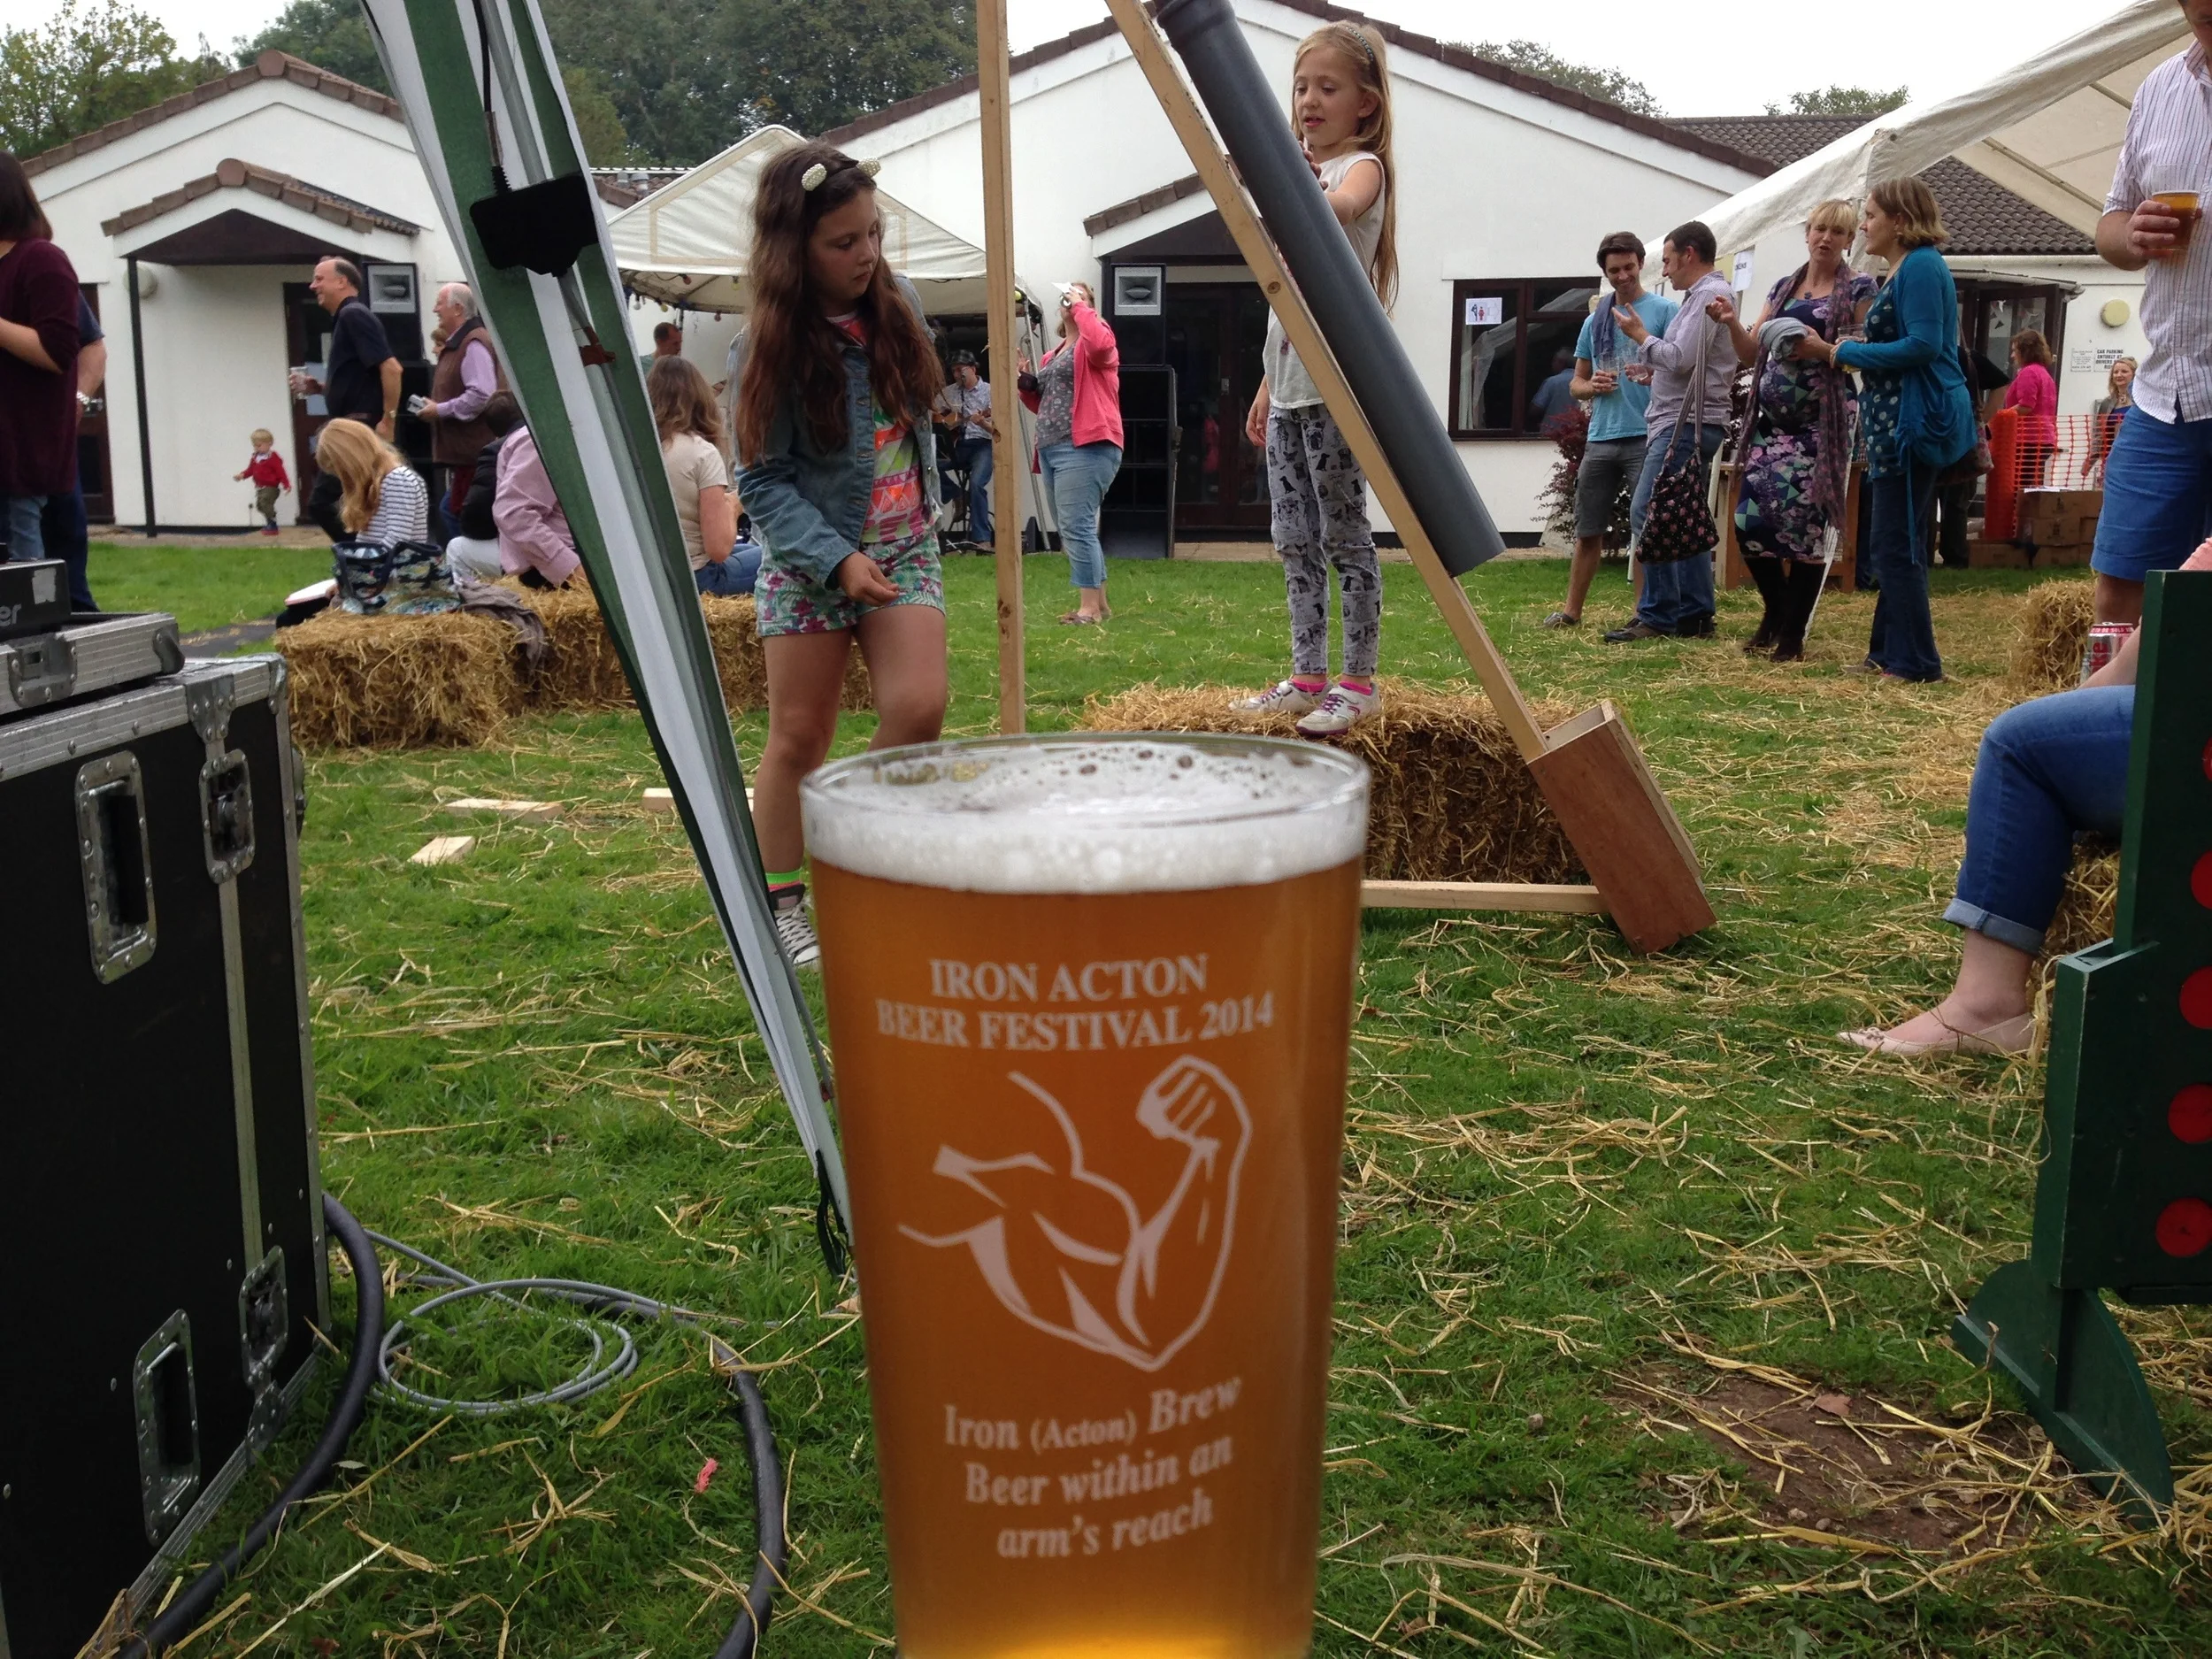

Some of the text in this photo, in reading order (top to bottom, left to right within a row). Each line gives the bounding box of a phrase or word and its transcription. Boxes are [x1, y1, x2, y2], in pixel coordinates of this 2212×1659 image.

[928, 953, 1210, 1002] IRON ACTON
[874, 990, 1275, 1051] BEER FESTIVAL 2014
[944, 1376, 1241, 1455] Iron (Acton) Brew
[965, 1436, 1233, 1505] Beer within an
[997, 1486, 1212, 1558] arm's reach
